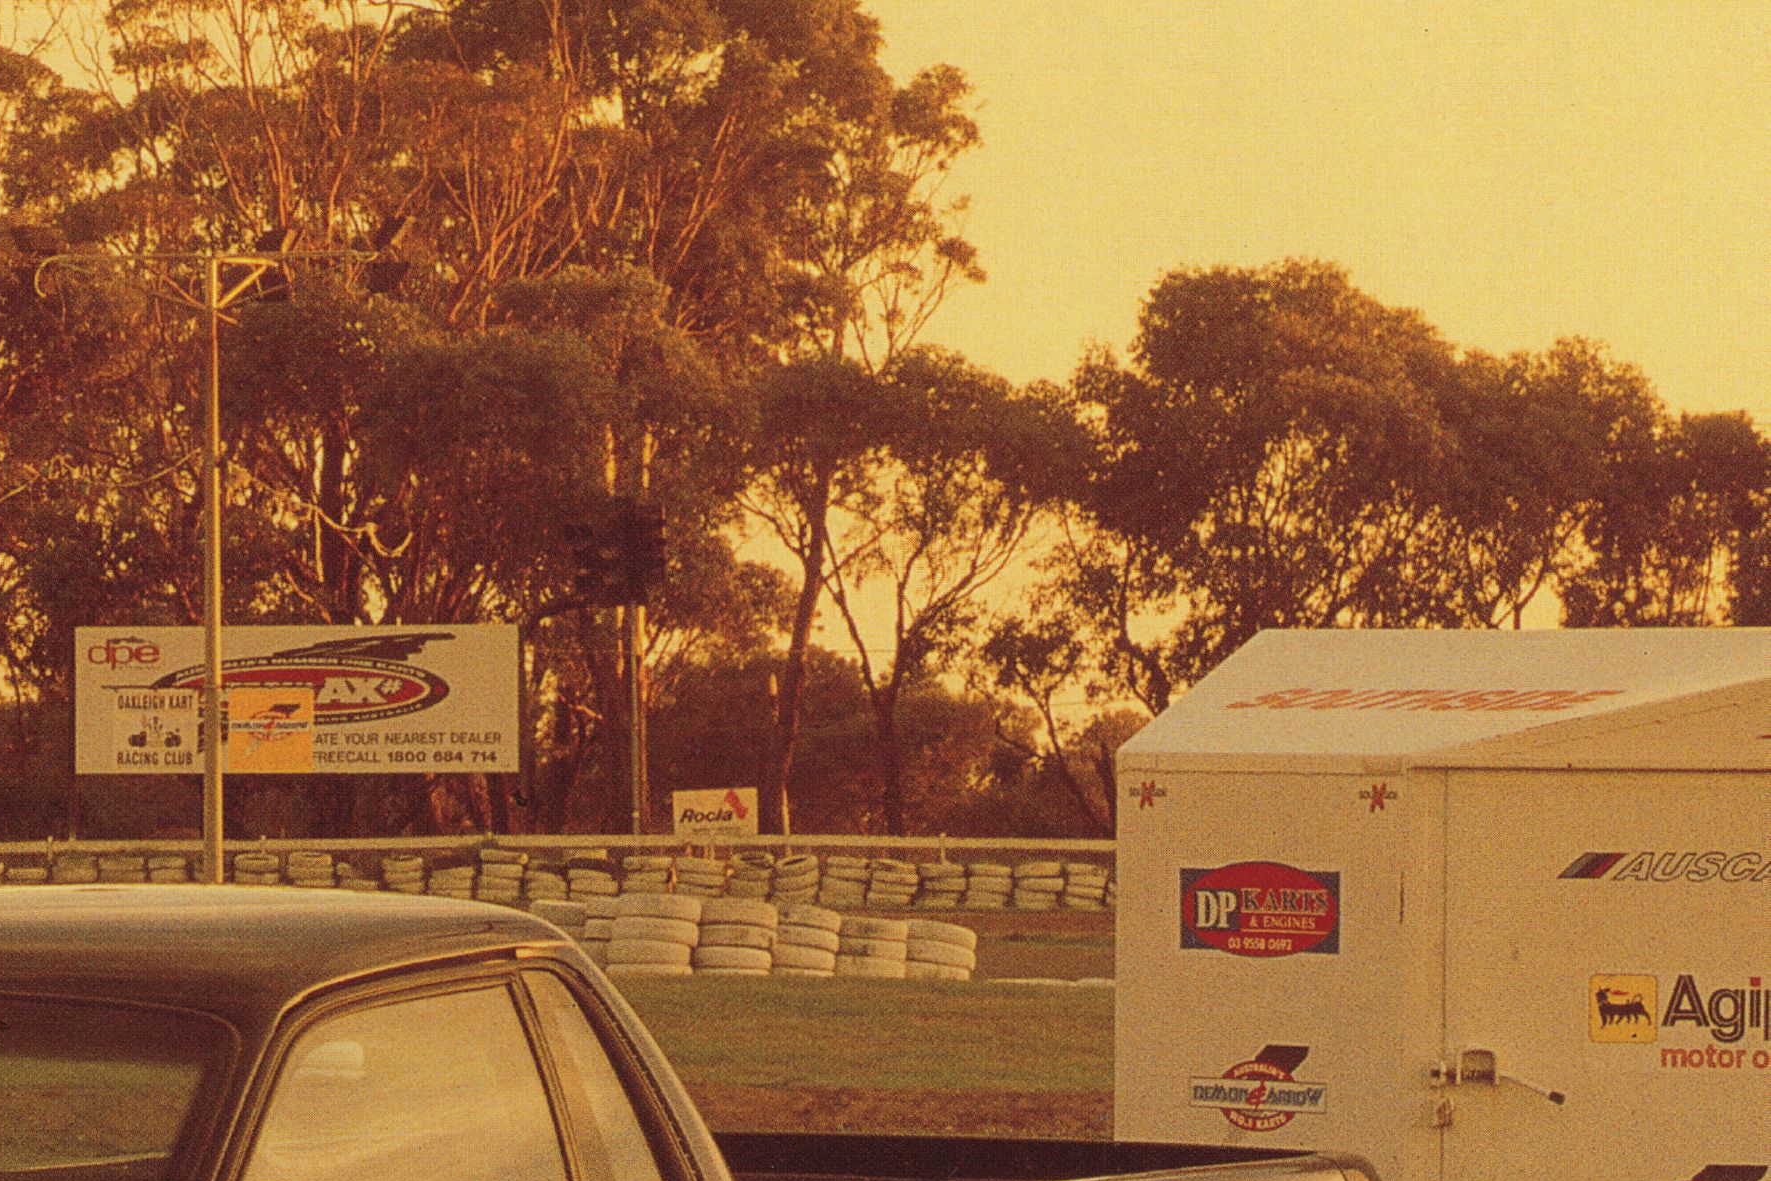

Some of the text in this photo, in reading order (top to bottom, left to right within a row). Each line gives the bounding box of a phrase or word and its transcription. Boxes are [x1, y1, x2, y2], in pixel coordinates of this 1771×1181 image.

[117, 695, 194, 709] OAKLEIGH KART
[344, 732, 379, 744] YOUR
[384, 732, 445, 744] NEAREST
[450, 732, 502, 744] DEALER
[117, 751, 194, 765] RACING CLUB
[388, 751, 427, 763] 1800
[471, 751, 498, 763] 714
[1240, 888, 1329, 913] KARTS
[1195, 890, 1238, 929] DP
[1249, 915, 1316, 929] & ENGINES
[1660, 1044, 1747, 1069] motor
